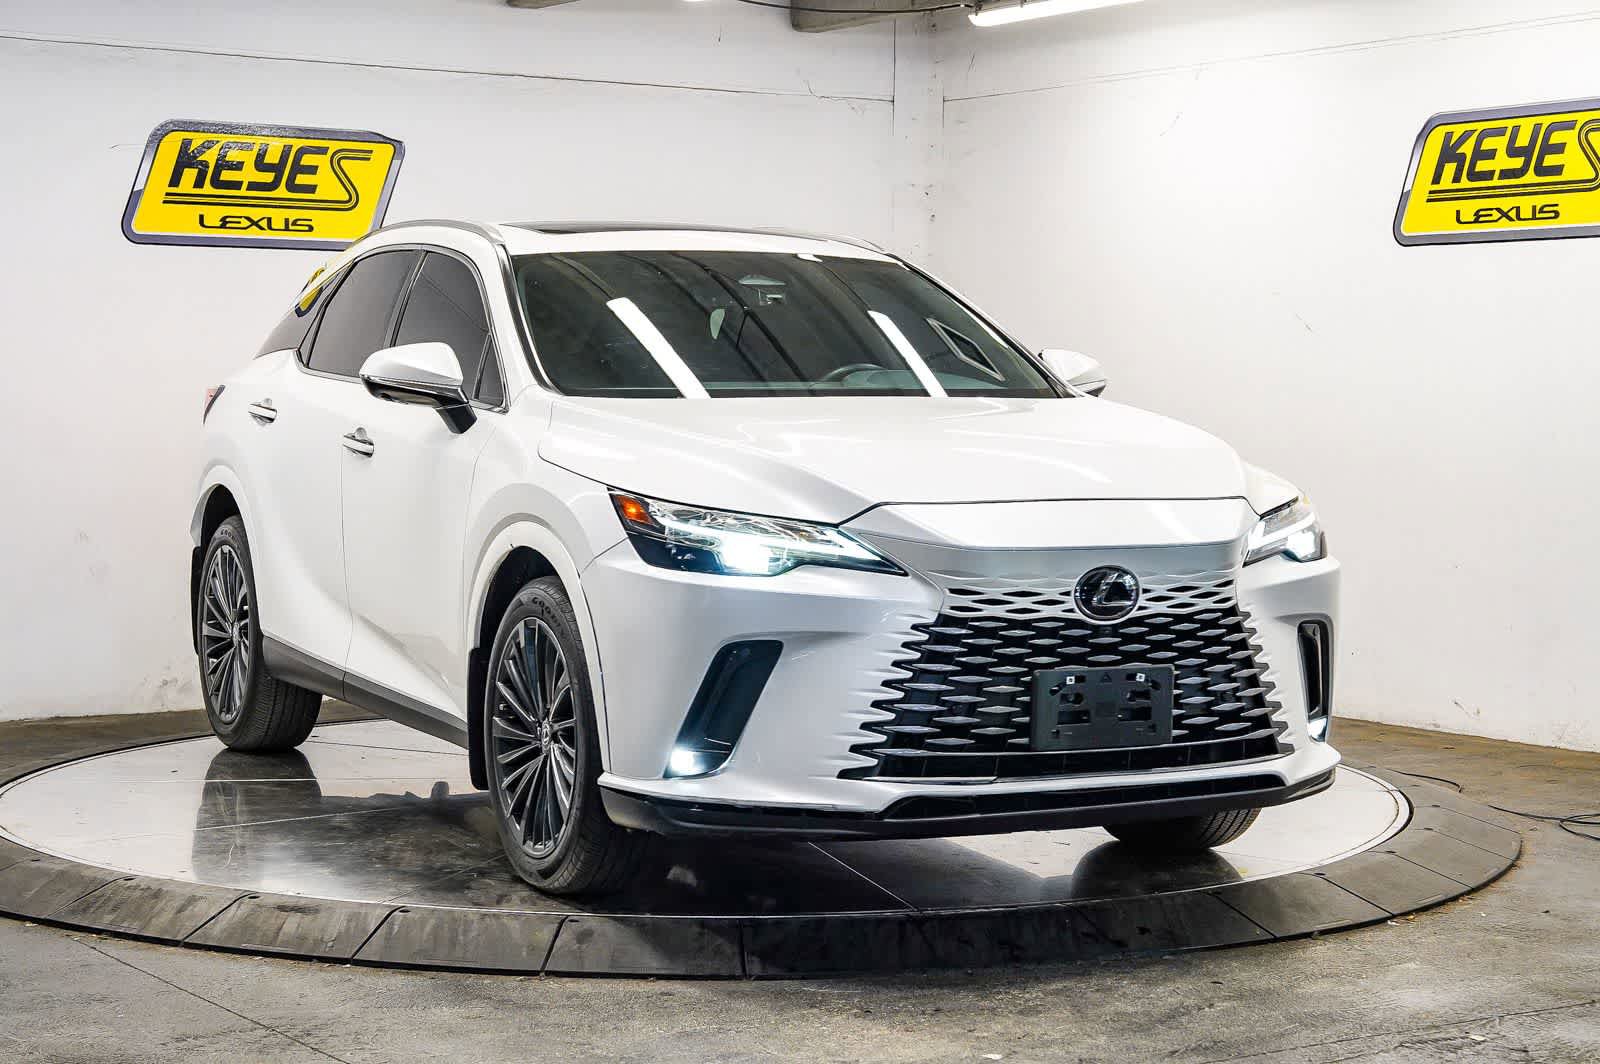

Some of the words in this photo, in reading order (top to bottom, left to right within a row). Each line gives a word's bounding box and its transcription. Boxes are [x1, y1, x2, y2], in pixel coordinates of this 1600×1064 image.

[162, 138, 373, 211] KEYES
[198, 213, 314, 233] LEXUS
[1455, 203, 1560, 224] LEXUS
